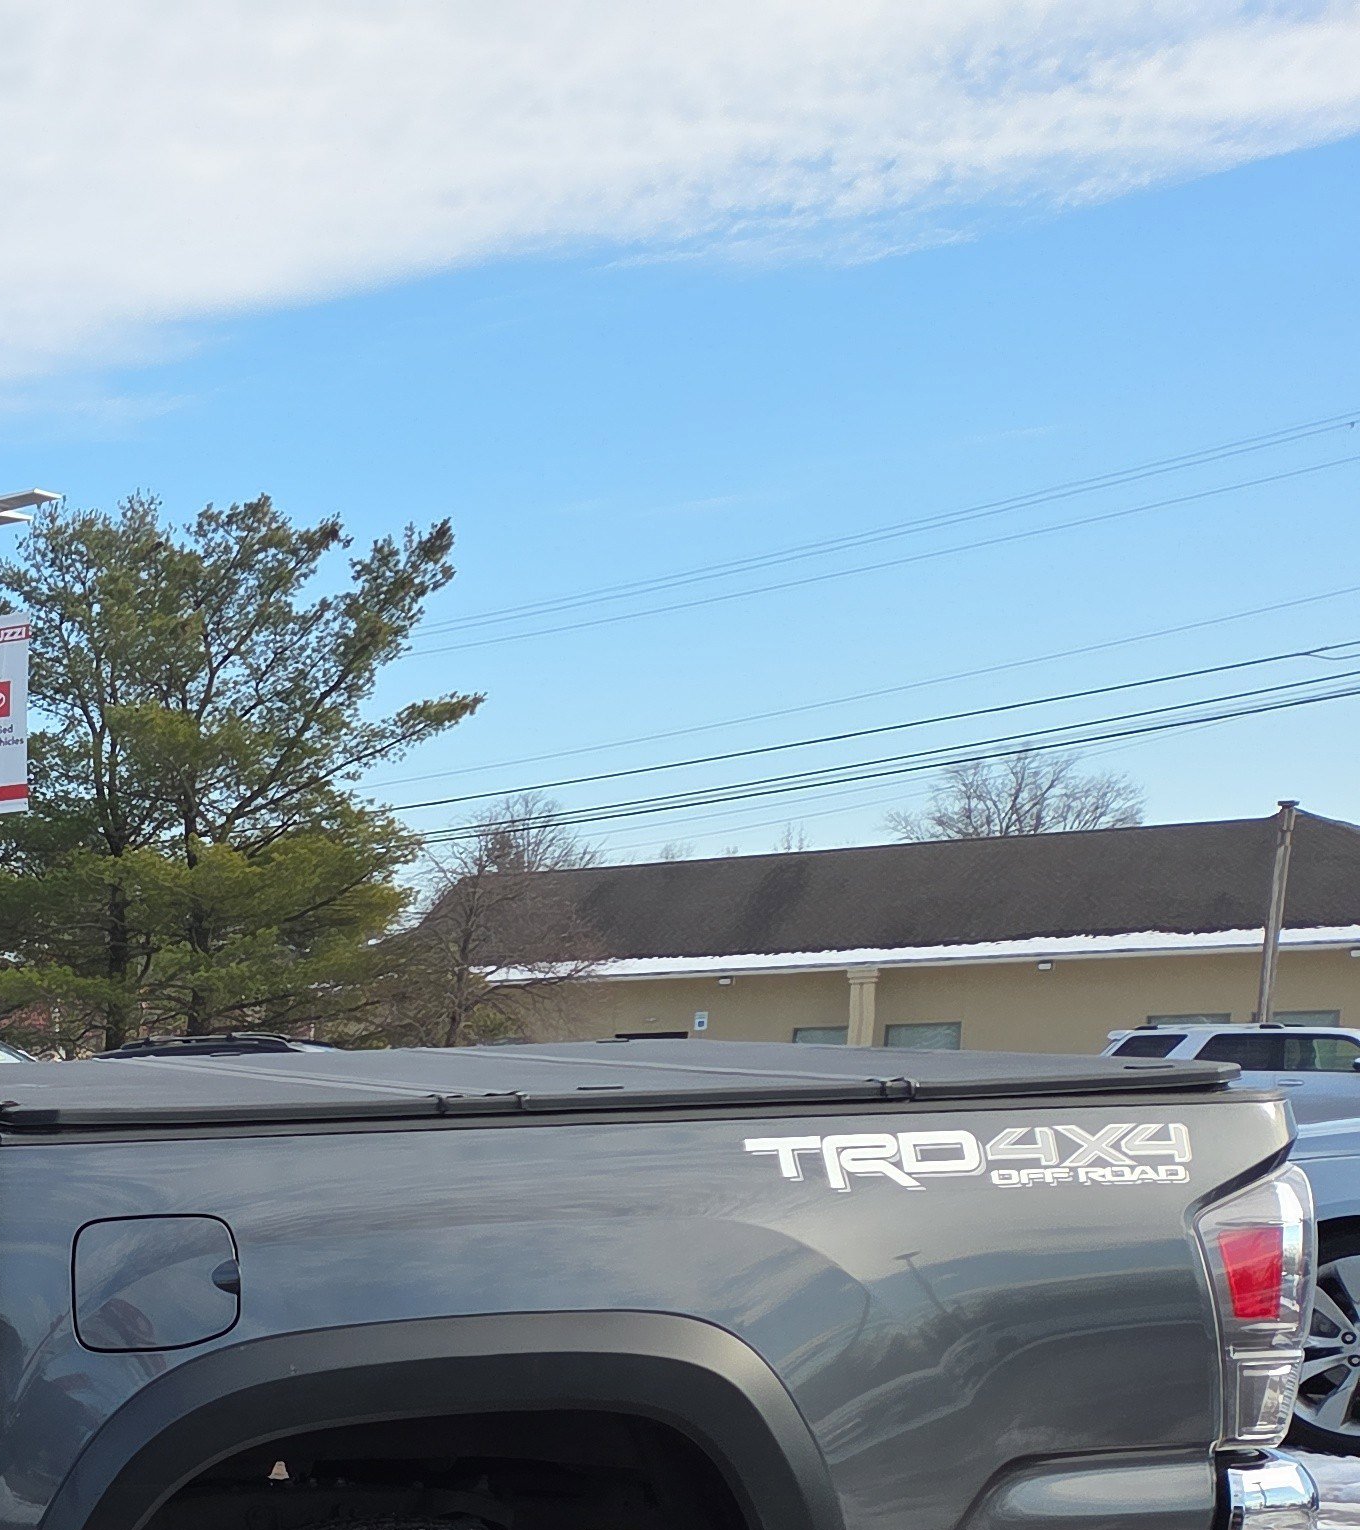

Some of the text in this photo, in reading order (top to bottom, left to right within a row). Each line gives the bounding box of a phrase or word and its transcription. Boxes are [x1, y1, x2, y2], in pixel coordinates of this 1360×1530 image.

[744, 1129, 986, 1192] TRD
[991, 1164, 1190, 1188] OFF ROAD
